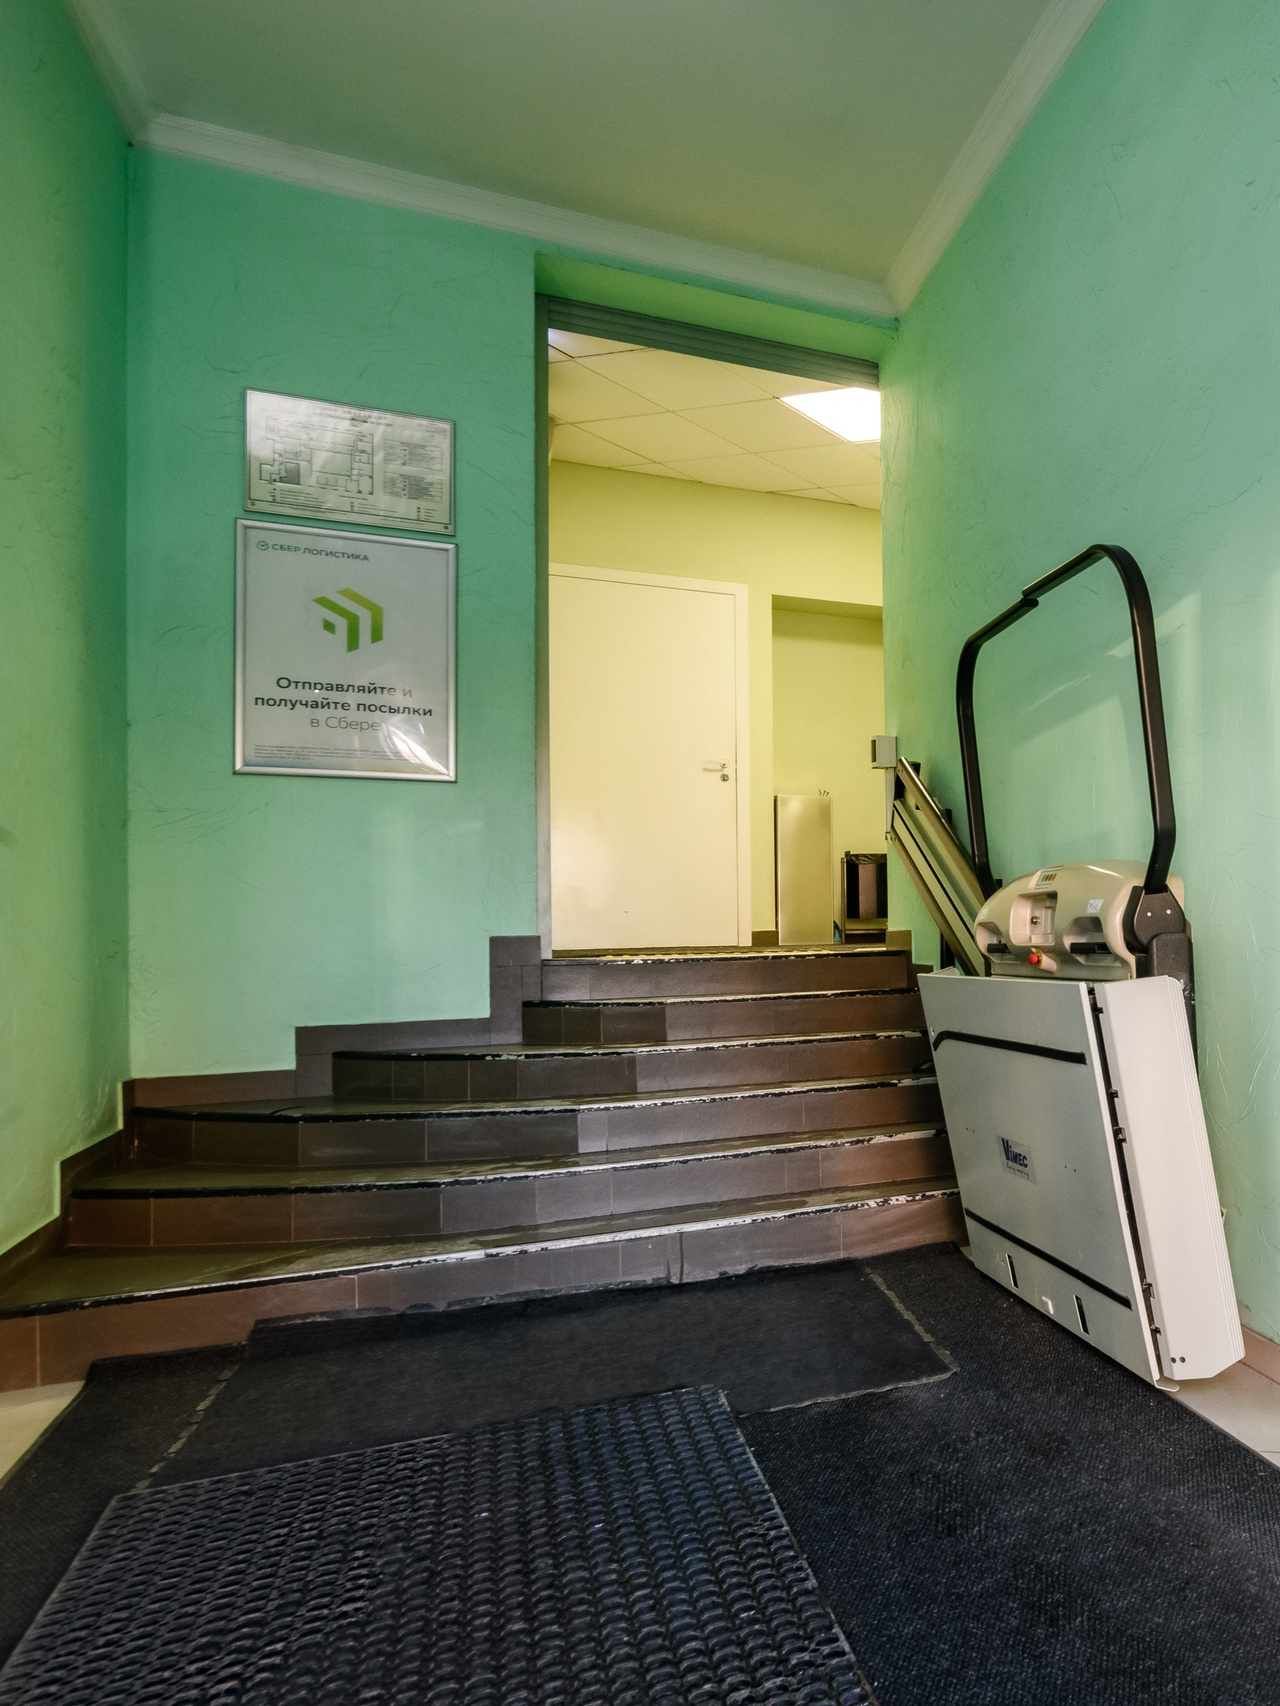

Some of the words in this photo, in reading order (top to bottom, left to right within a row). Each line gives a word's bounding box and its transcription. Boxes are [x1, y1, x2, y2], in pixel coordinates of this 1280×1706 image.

[271, 543, 301, 553] СБЕР
[302, 547, 370, 561] ЛОГИСТИКА
[276, 676, 397, 696] Отправляйте
[402, 688, 413, 698] и
[254, 697, 351, 711] получайте
[356, 703, 433, 717] посылки
[310, 717, 320, 728] в
[325, 716, 381, 732] Сбере
